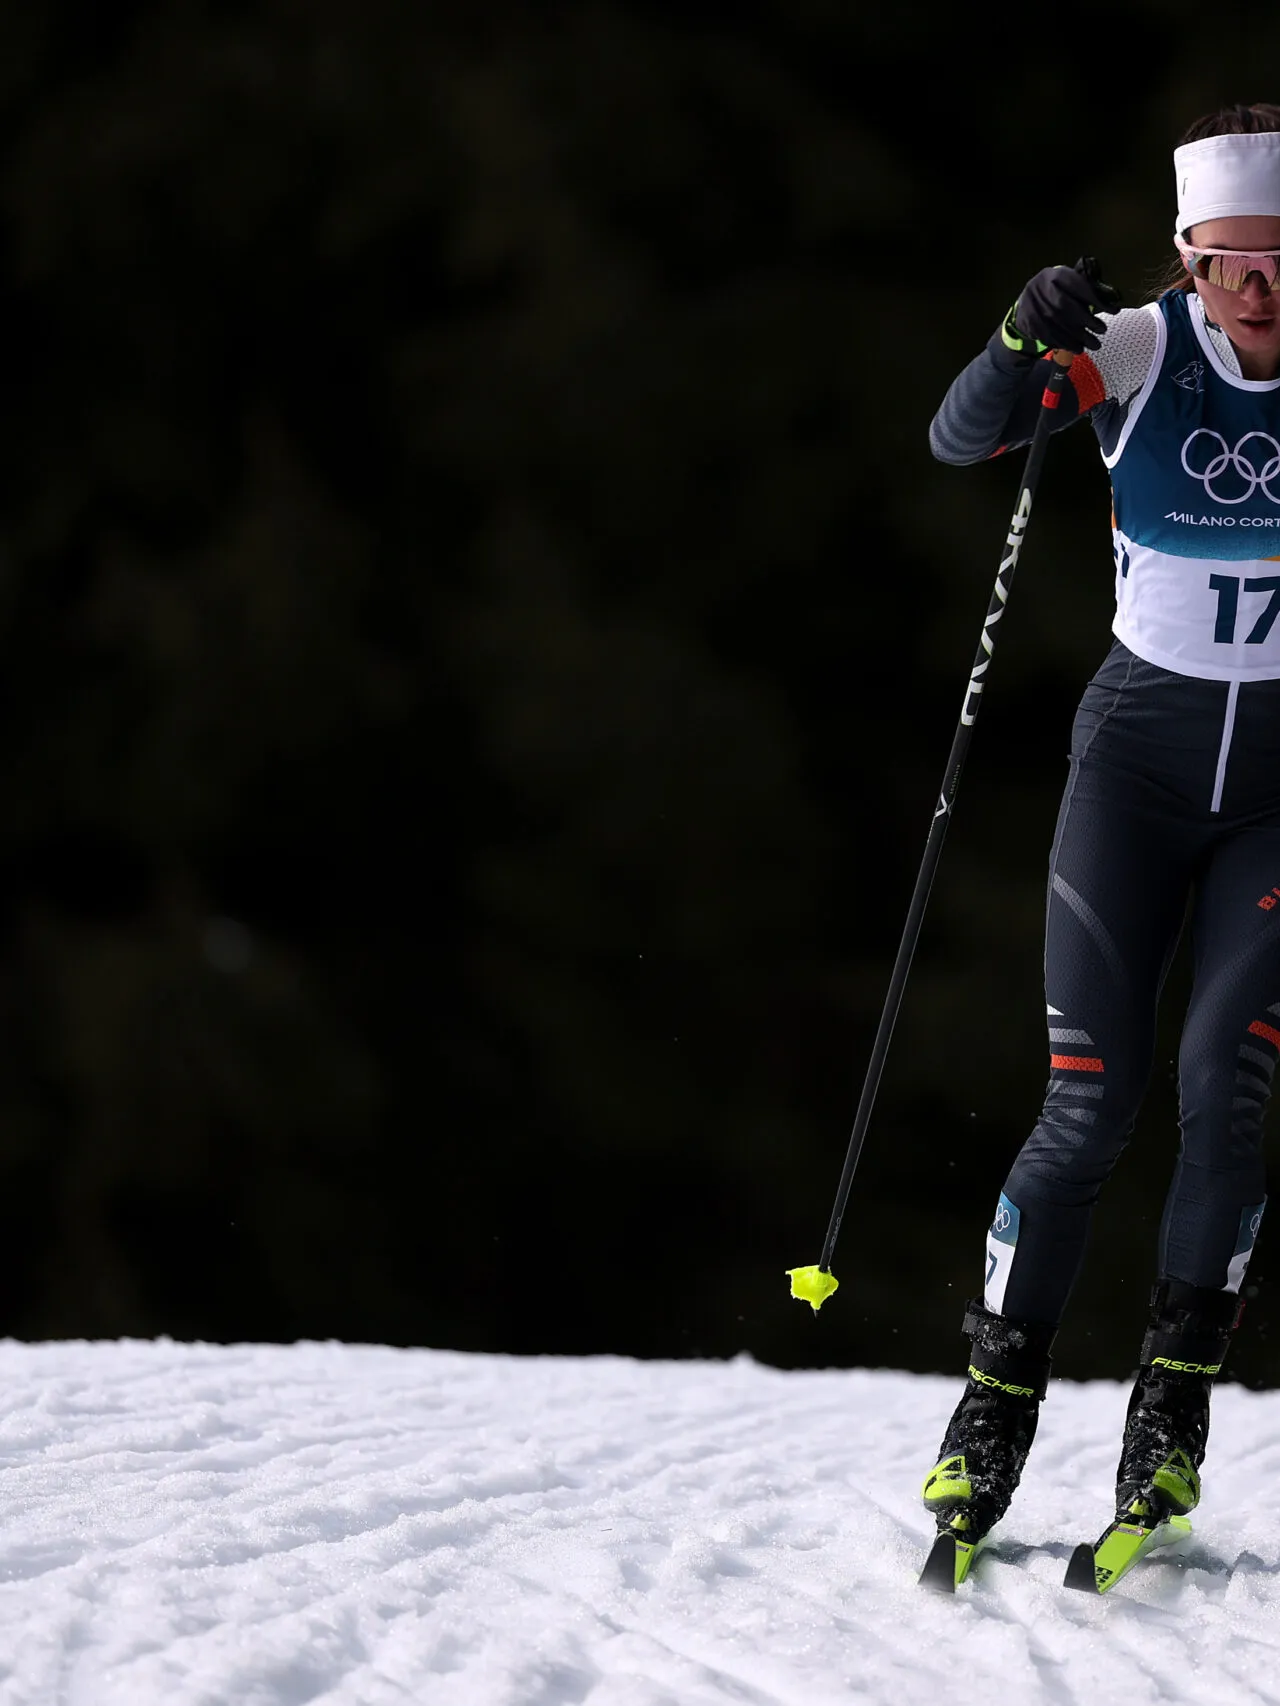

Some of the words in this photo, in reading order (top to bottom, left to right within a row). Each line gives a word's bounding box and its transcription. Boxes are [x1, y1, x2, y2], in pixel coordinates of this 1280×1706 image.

[1164, 511, 1236, 527] MILANO
[987, 1249, 998, 1286] 7
[968, 1364, 1035, 1398] FISCHER
